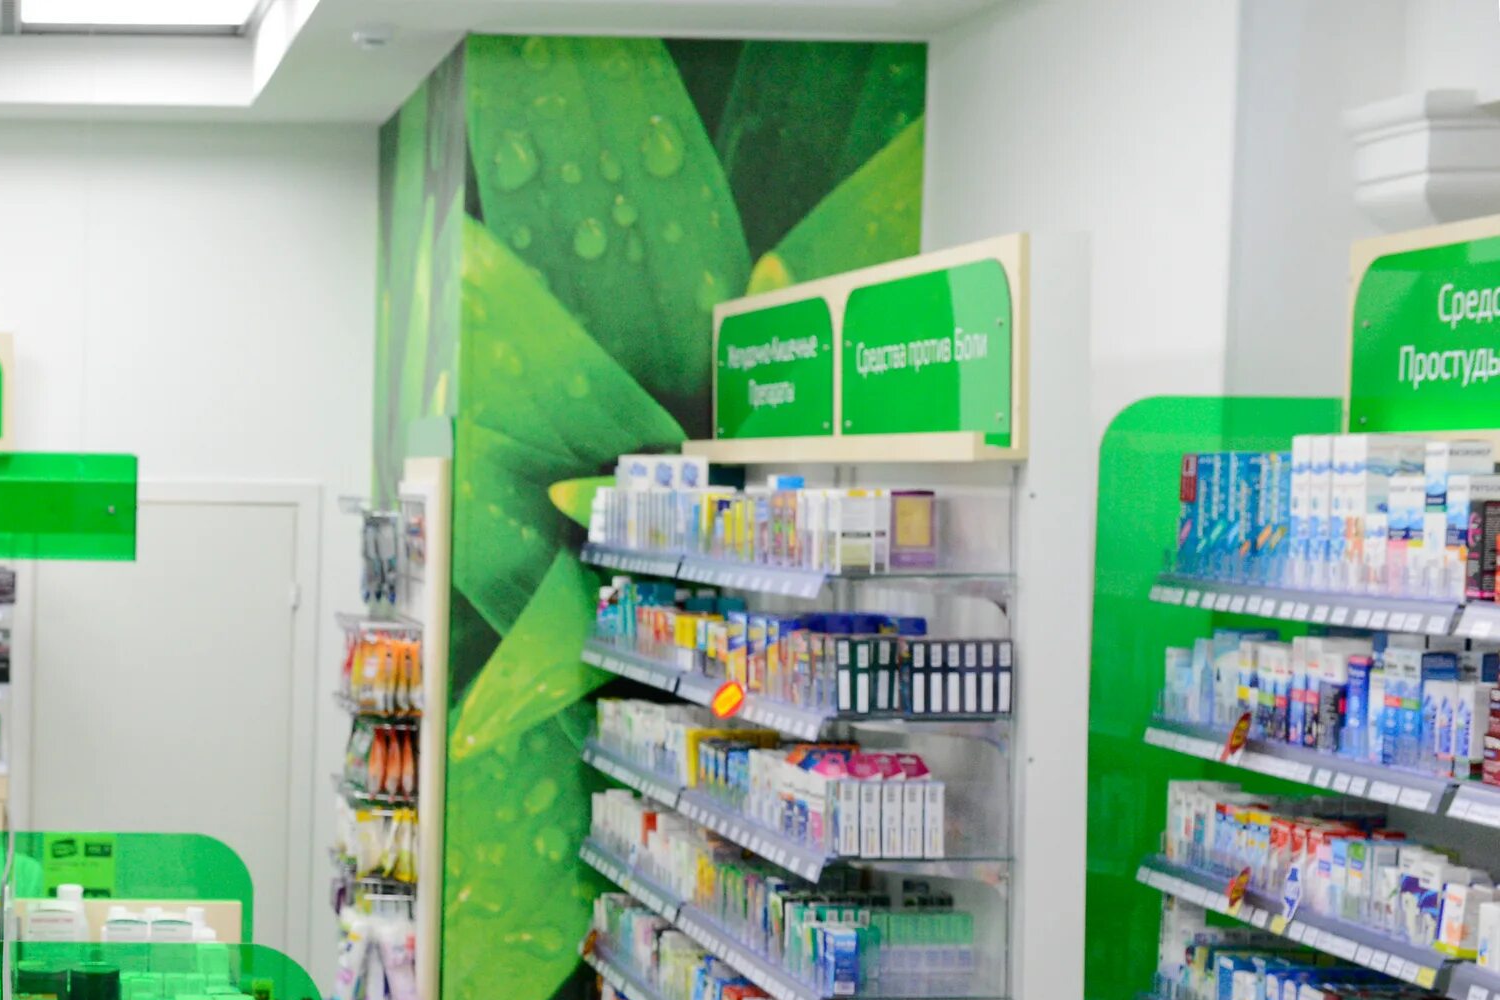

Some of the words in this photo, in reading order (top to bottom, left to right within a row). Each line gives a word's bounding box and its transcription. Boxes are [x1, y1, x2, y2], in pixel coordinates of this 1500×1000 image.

[1438, 283, 1500, 330] Средс
[856, 342, 906, 378] Средства
[908, 337, 951, 371] против
[954, 327, 988, 361] Боли
